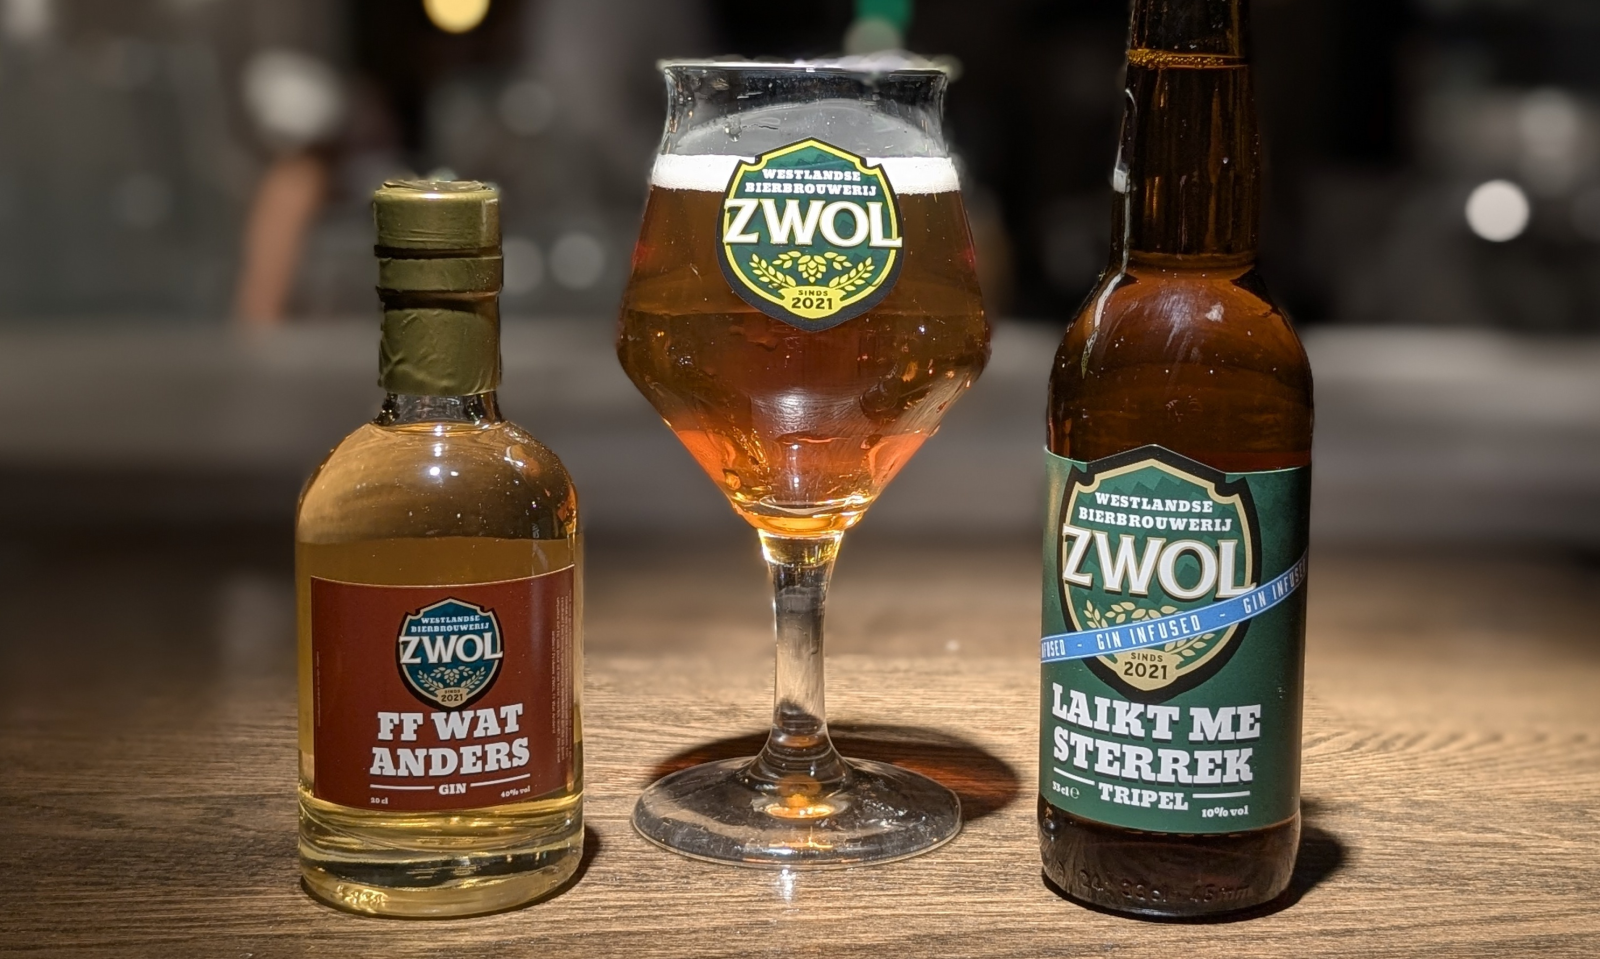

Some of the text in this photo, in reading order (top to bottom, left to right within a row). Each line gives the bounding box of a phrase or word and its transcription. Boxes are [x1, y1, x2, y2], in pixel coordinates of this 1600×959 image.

[762, 168, 861, 182] WESTLANDSE
[744, 182, 878, 197] BIERBROUWERIJ
[722, 198, 903, 249] ZWOL
[791, 297, 833, 310] 2021
[798, 289, 829, 297] SINDS
[1094, 491, 1214, 514] WESTLANDSE
[1078, 506, 1233, 532] BIERBROUWERIJ
[1061, 522, 1257, 600] ZWOL
[410, 622, 490, 633] BIERBROUWERIJ
[421, 615, 481, 624] WESTLANDSE
[1096, 633, 1122, 650] GIN
[1130, 614, 1201, 644] INFUSED
[1243, 590, 1267, 614] GIN
[398, 632, 503, 665] ZWOL
[1130, 652, 1163, 663] SINDS
[1123, 661, 1168, 680] 2021
[441, 694, 463, 703] 2021
[377, 702, 524, 741] FF WAT
[1051, 681, 1262, 741] LAIKT ME
[370, 736, 531, 777] ANDERS
[1053, 725, 1254, 785] STERREK
[438, 782, 467, 796] GIN
[1098, 782, 1189, 811] TRIPEL
[1201, 805, 1249, 819] 10% vol
